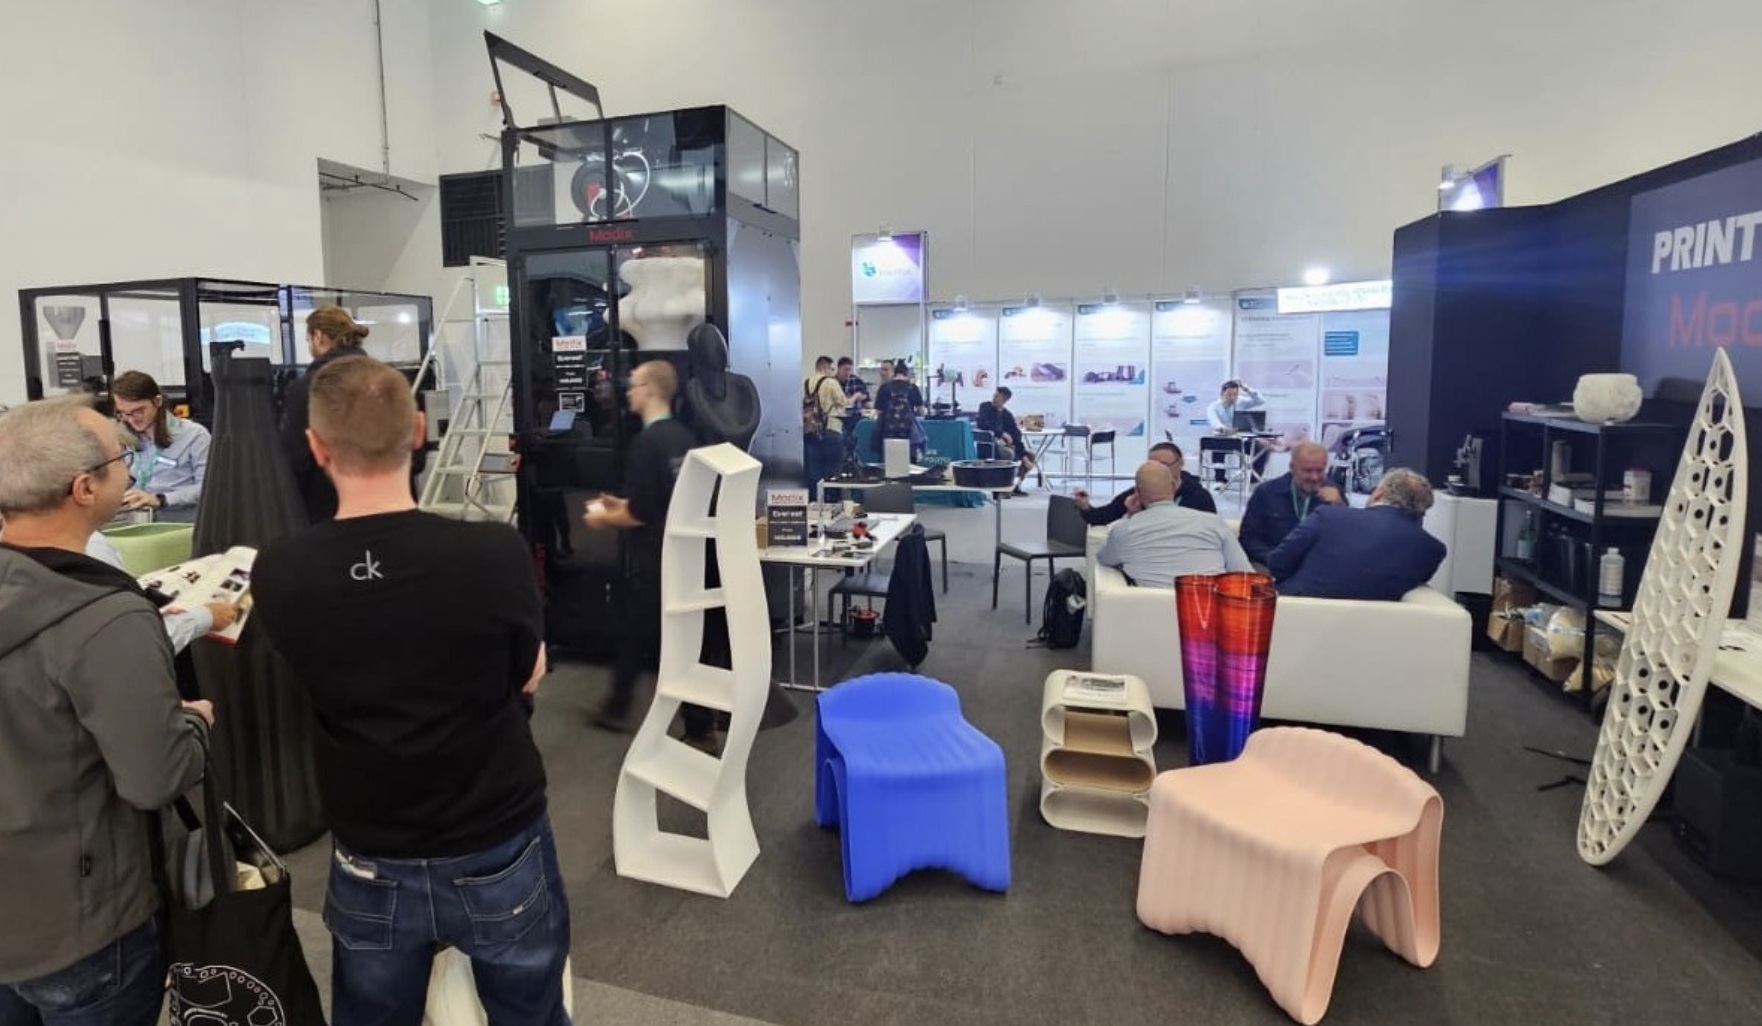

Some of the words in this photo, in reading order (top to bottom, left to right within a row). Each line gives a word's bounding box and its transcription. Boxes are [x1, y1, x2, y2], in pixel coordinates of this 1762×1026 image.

[590, 229, 633, 241] Modix
[1651, 210, 1762, 274] PRINT
[350, 549, 383, 580] ck
